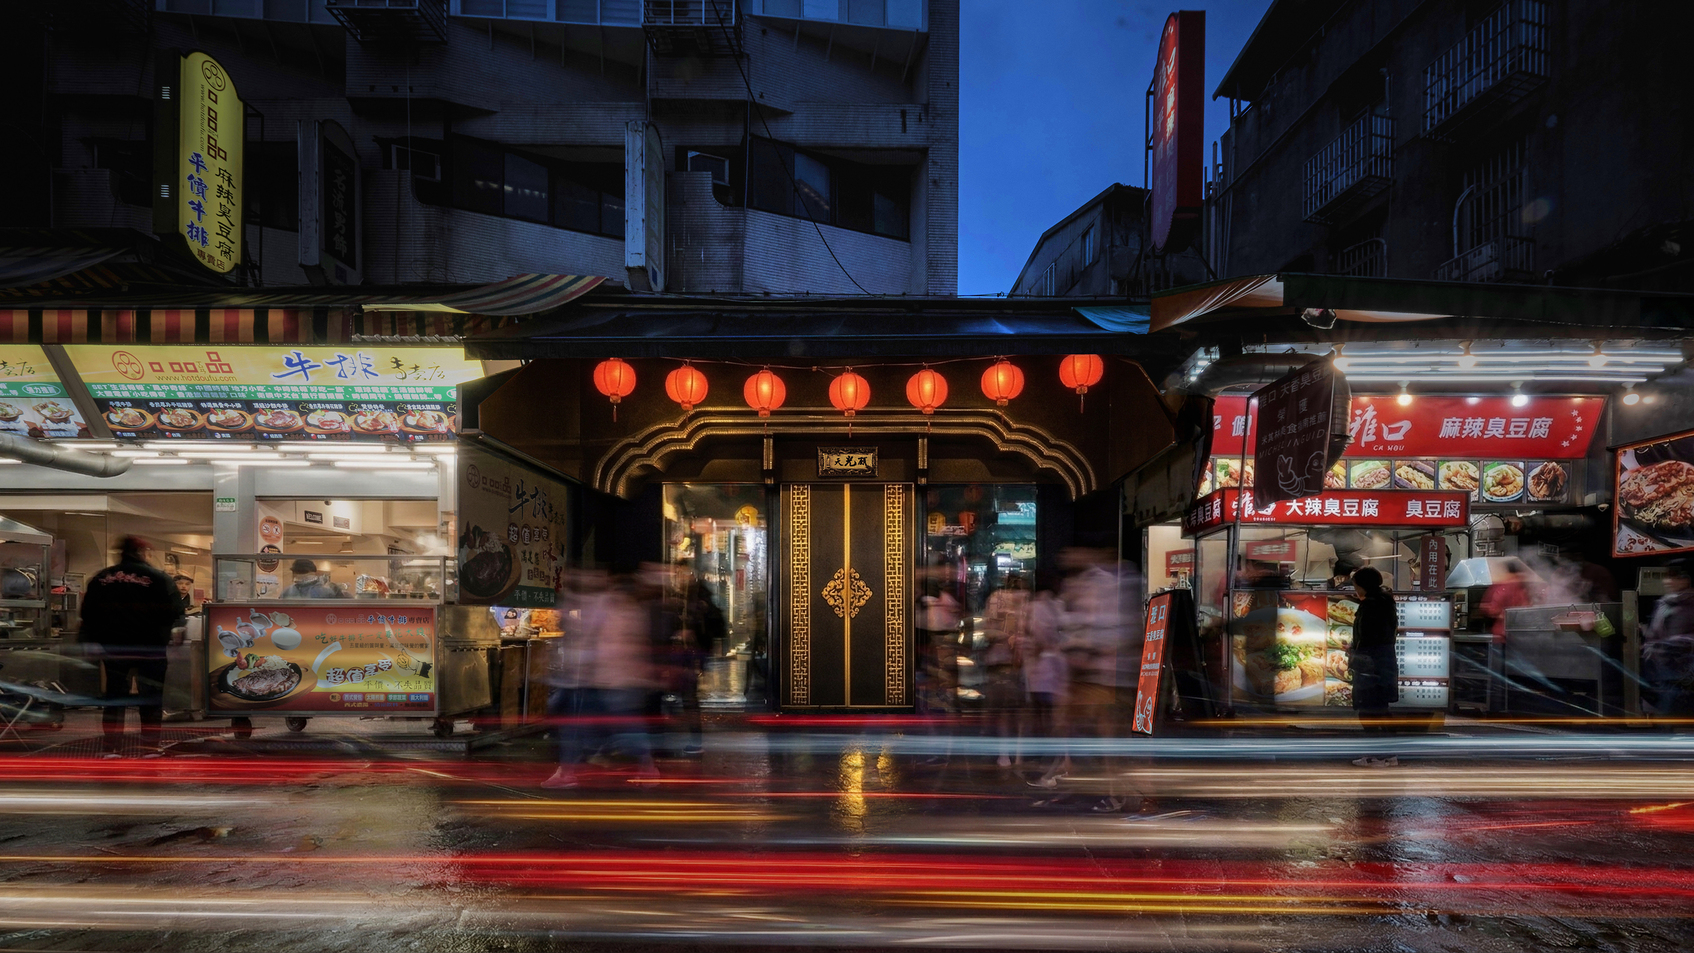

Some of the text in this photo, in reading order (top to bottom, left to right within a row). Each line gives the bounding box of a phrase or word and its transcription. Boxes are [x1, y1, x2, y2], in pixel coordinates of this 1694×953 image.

[186, 152, 209, 247] 平價牛排
[215, 166, 236, 262] 麻辣臭豆腐
[197, 247, 226, 272] 專賣店
[272, 350, 380, 382] 牛排
[155, 374, 238, 383] www.hotdoufu.com
[1260, 411, 1328, 446] 米其林美食指南推薦
[1439, 417, 1553, 439] 麻辣臭豆腐
[1286, 498, 1380, 517] 大辣臭豆腐
[1406, 499, 1461, 518] 臭豆腐
[508, 523, 550, 546] 超值享受
[1428, 539, 1438, 588] 內用在此
[367, 615, 408, 626] 平價牛排
[1150, 604, 1167, 625] 雅口
[326, 659, 393, 686] 超值享受
